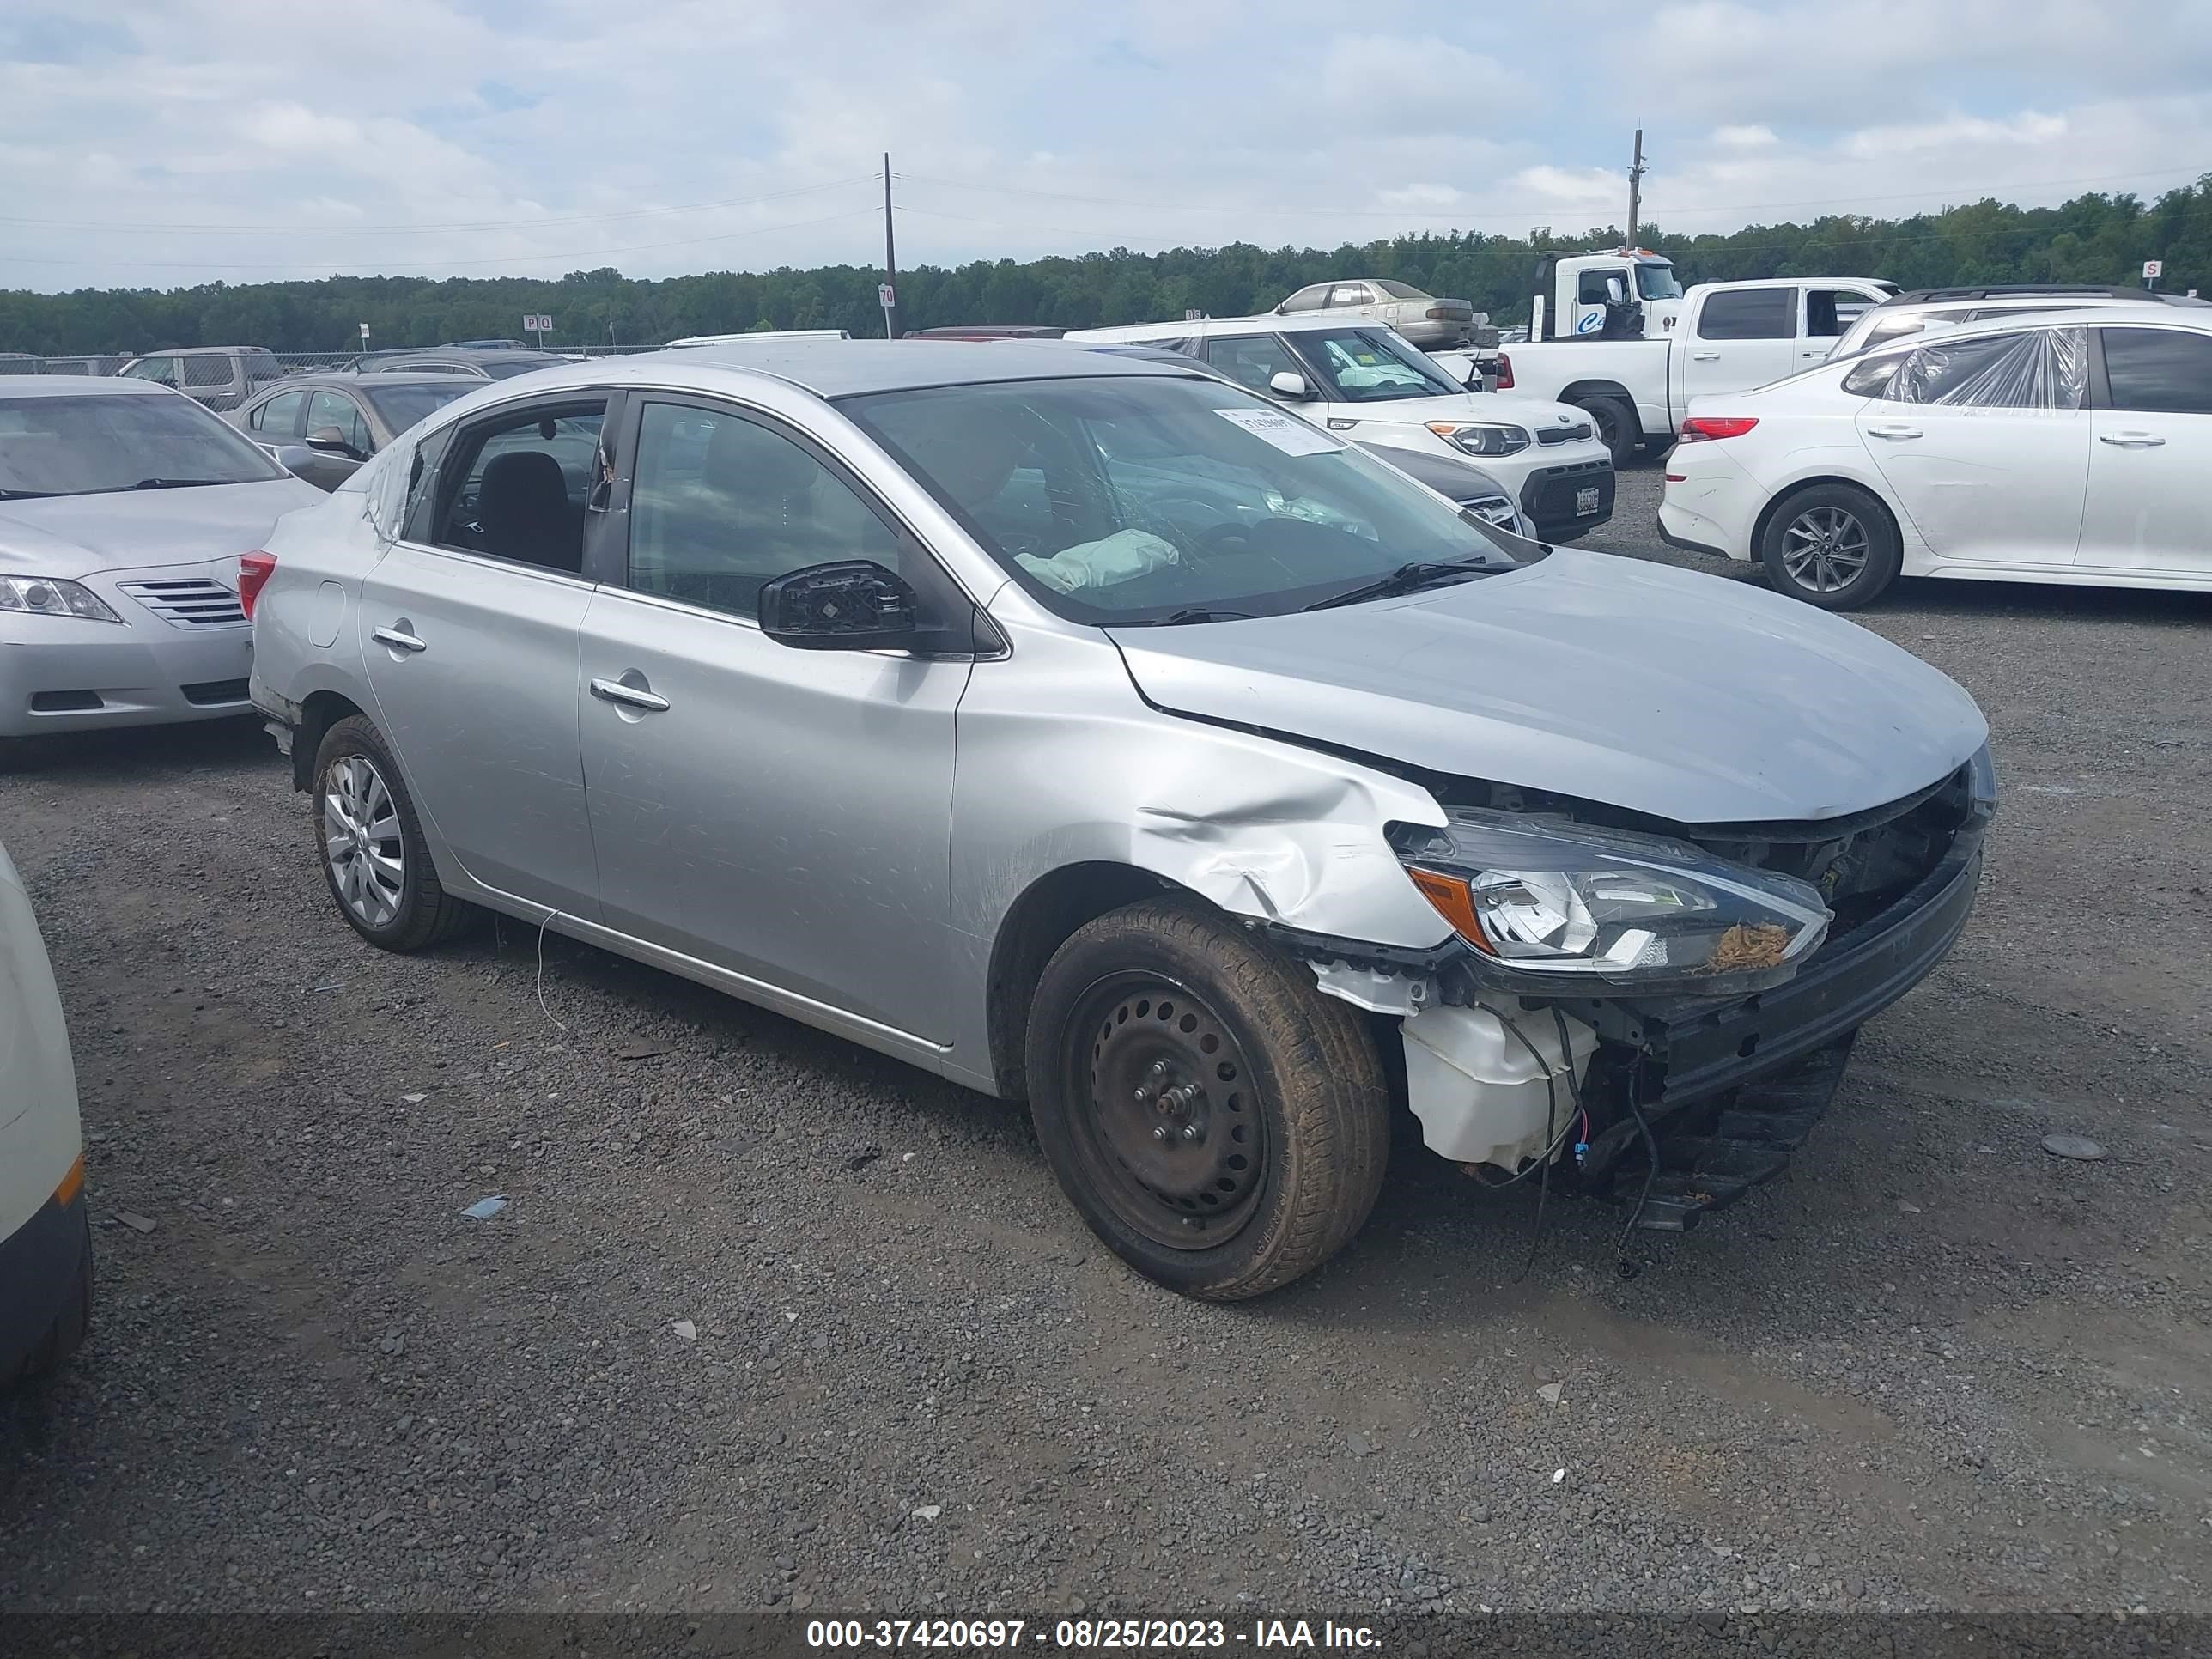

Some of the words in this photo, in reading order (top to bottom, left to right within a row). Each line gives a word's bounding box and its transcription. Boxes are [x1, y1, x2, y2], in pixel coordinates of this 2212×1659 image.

[2148, 264, 2157, 275] S
[880, 290, 892, 302] 70
[529, 319, 534, 328] P
[542, 318, 550, 328] Q
